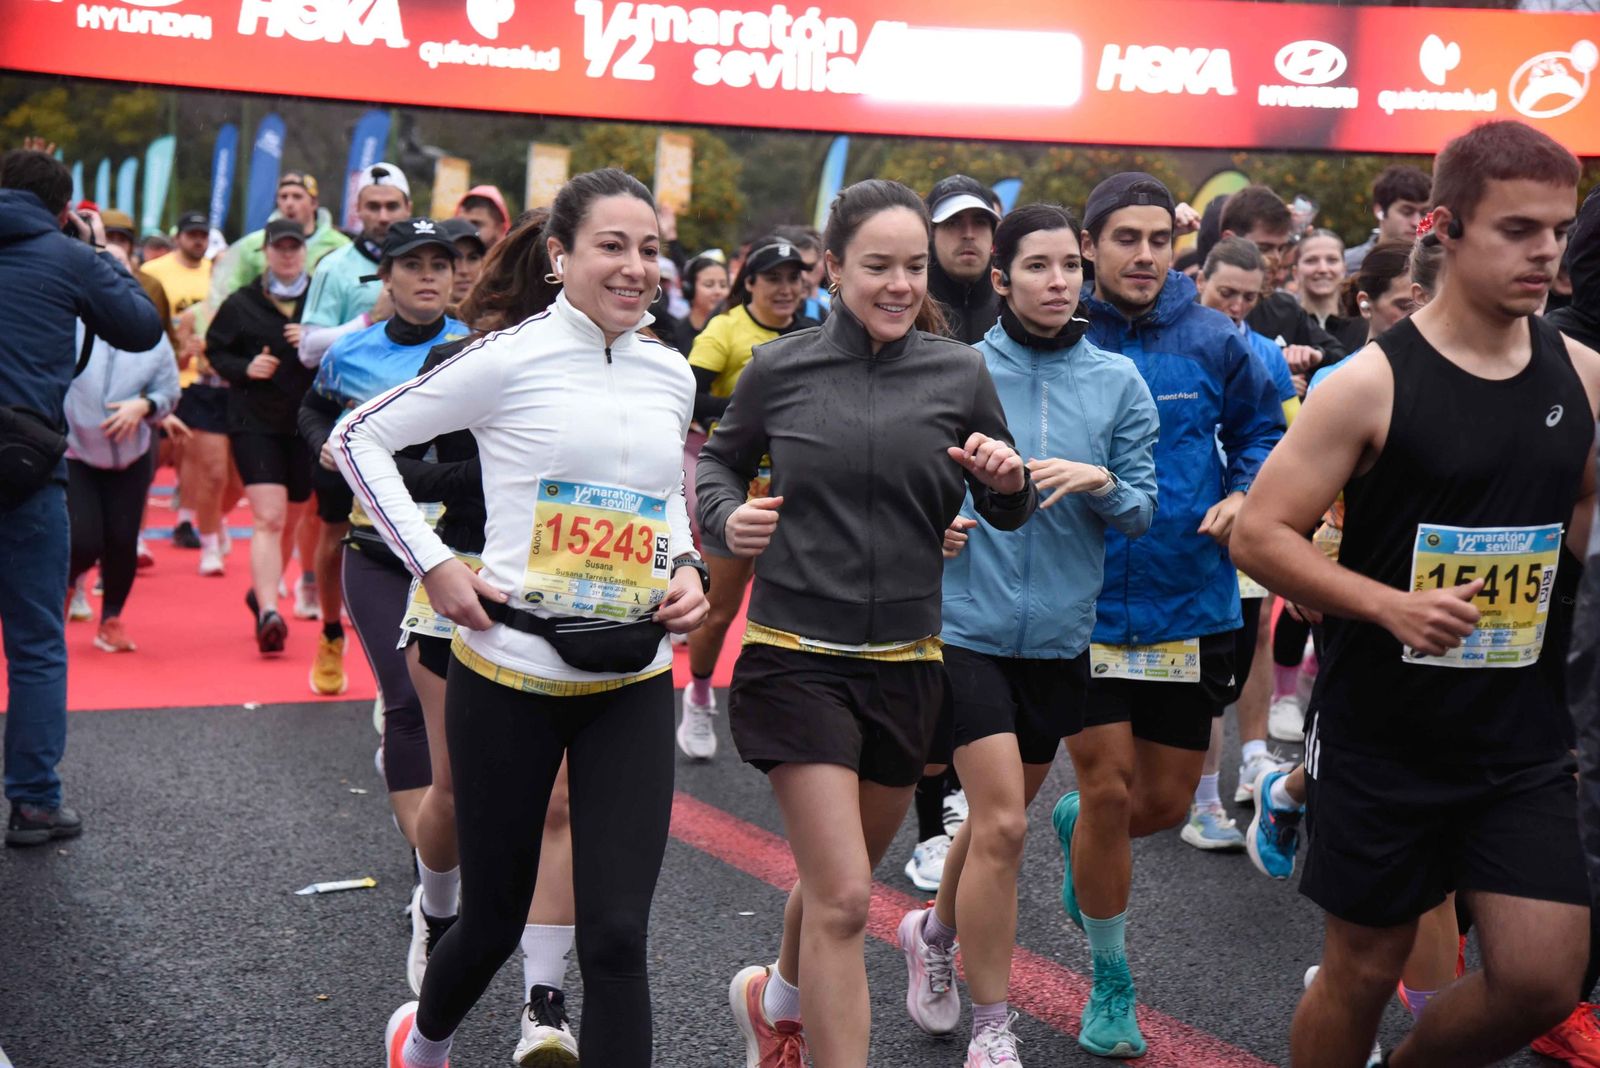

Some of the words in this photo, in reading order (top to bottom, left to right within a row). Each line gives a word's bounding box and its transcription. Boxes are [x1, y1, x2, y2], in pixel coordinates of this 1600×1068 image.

[77, 4, 212, 40] HYUNDAI
[237, 0, 410, 48] HOKA
[637, 3, 858, 54] maratón
[692, 48, 862, 94] sevilla
[1096, 43, 1238, 96] HOKA
[1041, 381, 1049, 414] UNDER
[1040, 415, 1048, 457] ARMOUR
[590, 486, 637, 502] maratón
[600, 498, 637, 512] sevilla
[546, 512, 654, 565] 15243
[1474, 532, 1526, 543] maratón
[1486, 541, 1525, 551] sevilla
[555, 568, 583, 580] Susana
[584, 572, 608, 582] Tarres
[608, 575, 638, 587] Casellas
[584, 559, 614, 571] Susana
[1428, 562, 1542, 605] 15415
[571, 601, 594, 611] HOKA
[1461, 652, 1485, 660] HOKA
